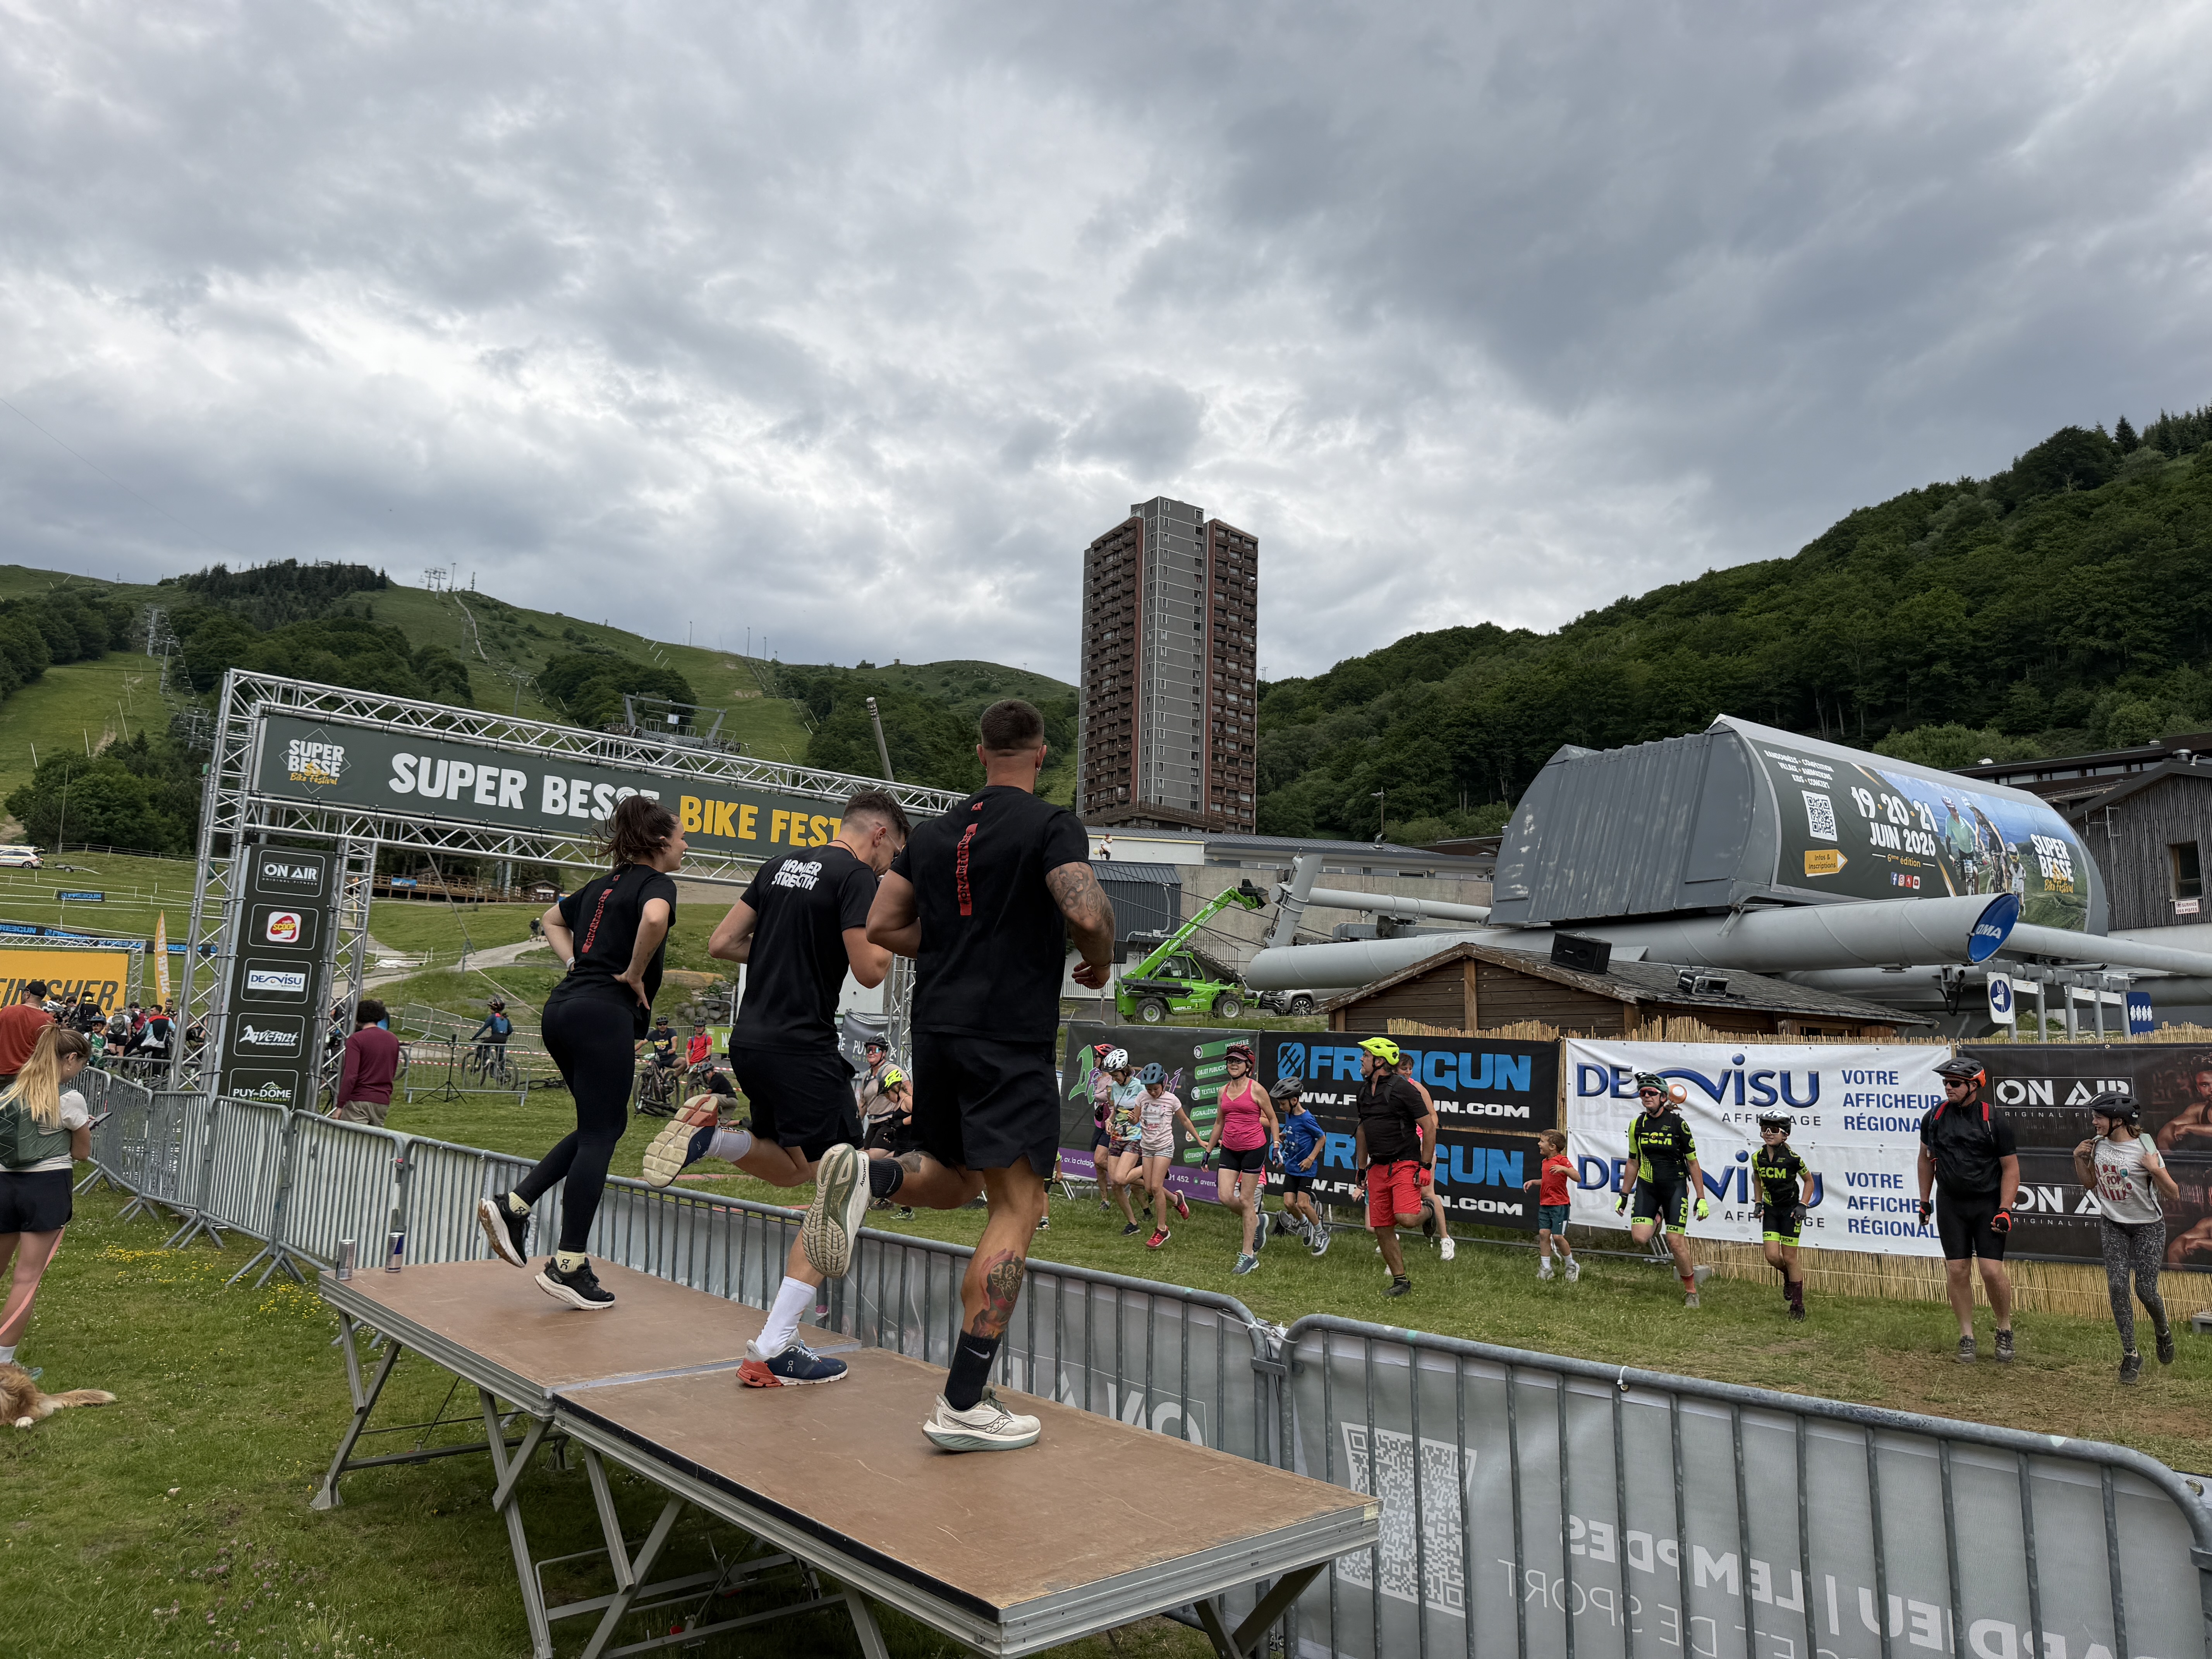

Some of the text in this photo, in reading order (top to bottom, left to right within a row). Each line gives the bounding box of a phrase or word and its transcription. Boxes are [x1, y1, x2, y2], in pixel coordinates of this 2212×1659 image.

[289, 739, 345, 762] SUPER
[288, 755, 341, 777] BESSE
[1778, 761, 1832, 780] VILLAGE ANIMATIONS
[290, 772, 338, 785] Bike Festival
[1791, 774, 1830, 789] KIDS CONCERT
[388, 752, 527, 809] SUPER
[541, 775, 659, 821] BES
[680, 795, 758, 840] BIKE
[1870, 822, 1936, 857] JUIN 2026
[2030, 834, 2070, 860] SUPER
[1808, 861, 1836, 870] Inscriptions
[1900, 856, 1921, 868] édition
[2038, 855, 2074, 882] BESSE
[264, 864, 317, 880] ON AIR
[2044, 879, 2074, 893] Bike Festival
[0, 924, 36, 934] REEGUN
[1975, 924, 2002, 939] OMA
[1209, 1065, 1227, 1073] PUBLICIT
[1841, 1070, 1899, 1085] VOTRE
[1997, 1080, 2053, 1106] ON
[1722, 1112, 1821, 1126] AFFIAGE
[1844, 1113, 1921, 1132] RÉGIONA
[1641, 1132, 1672, 1145] ECM
[1759, 1167, 1786, 1178] ECM
[1845, 1172, 1903, 1189] VOTRE
[2107, 1176, 2121, 1185] POP
[2012, 1187, 2064, 1213] ON
[1679, 1197, 1688, 1224] ECM
[1848, 1216, 1939, 1238] RÉGIONAL
[2014, 1217, 2073, 1226] RIGINAL
